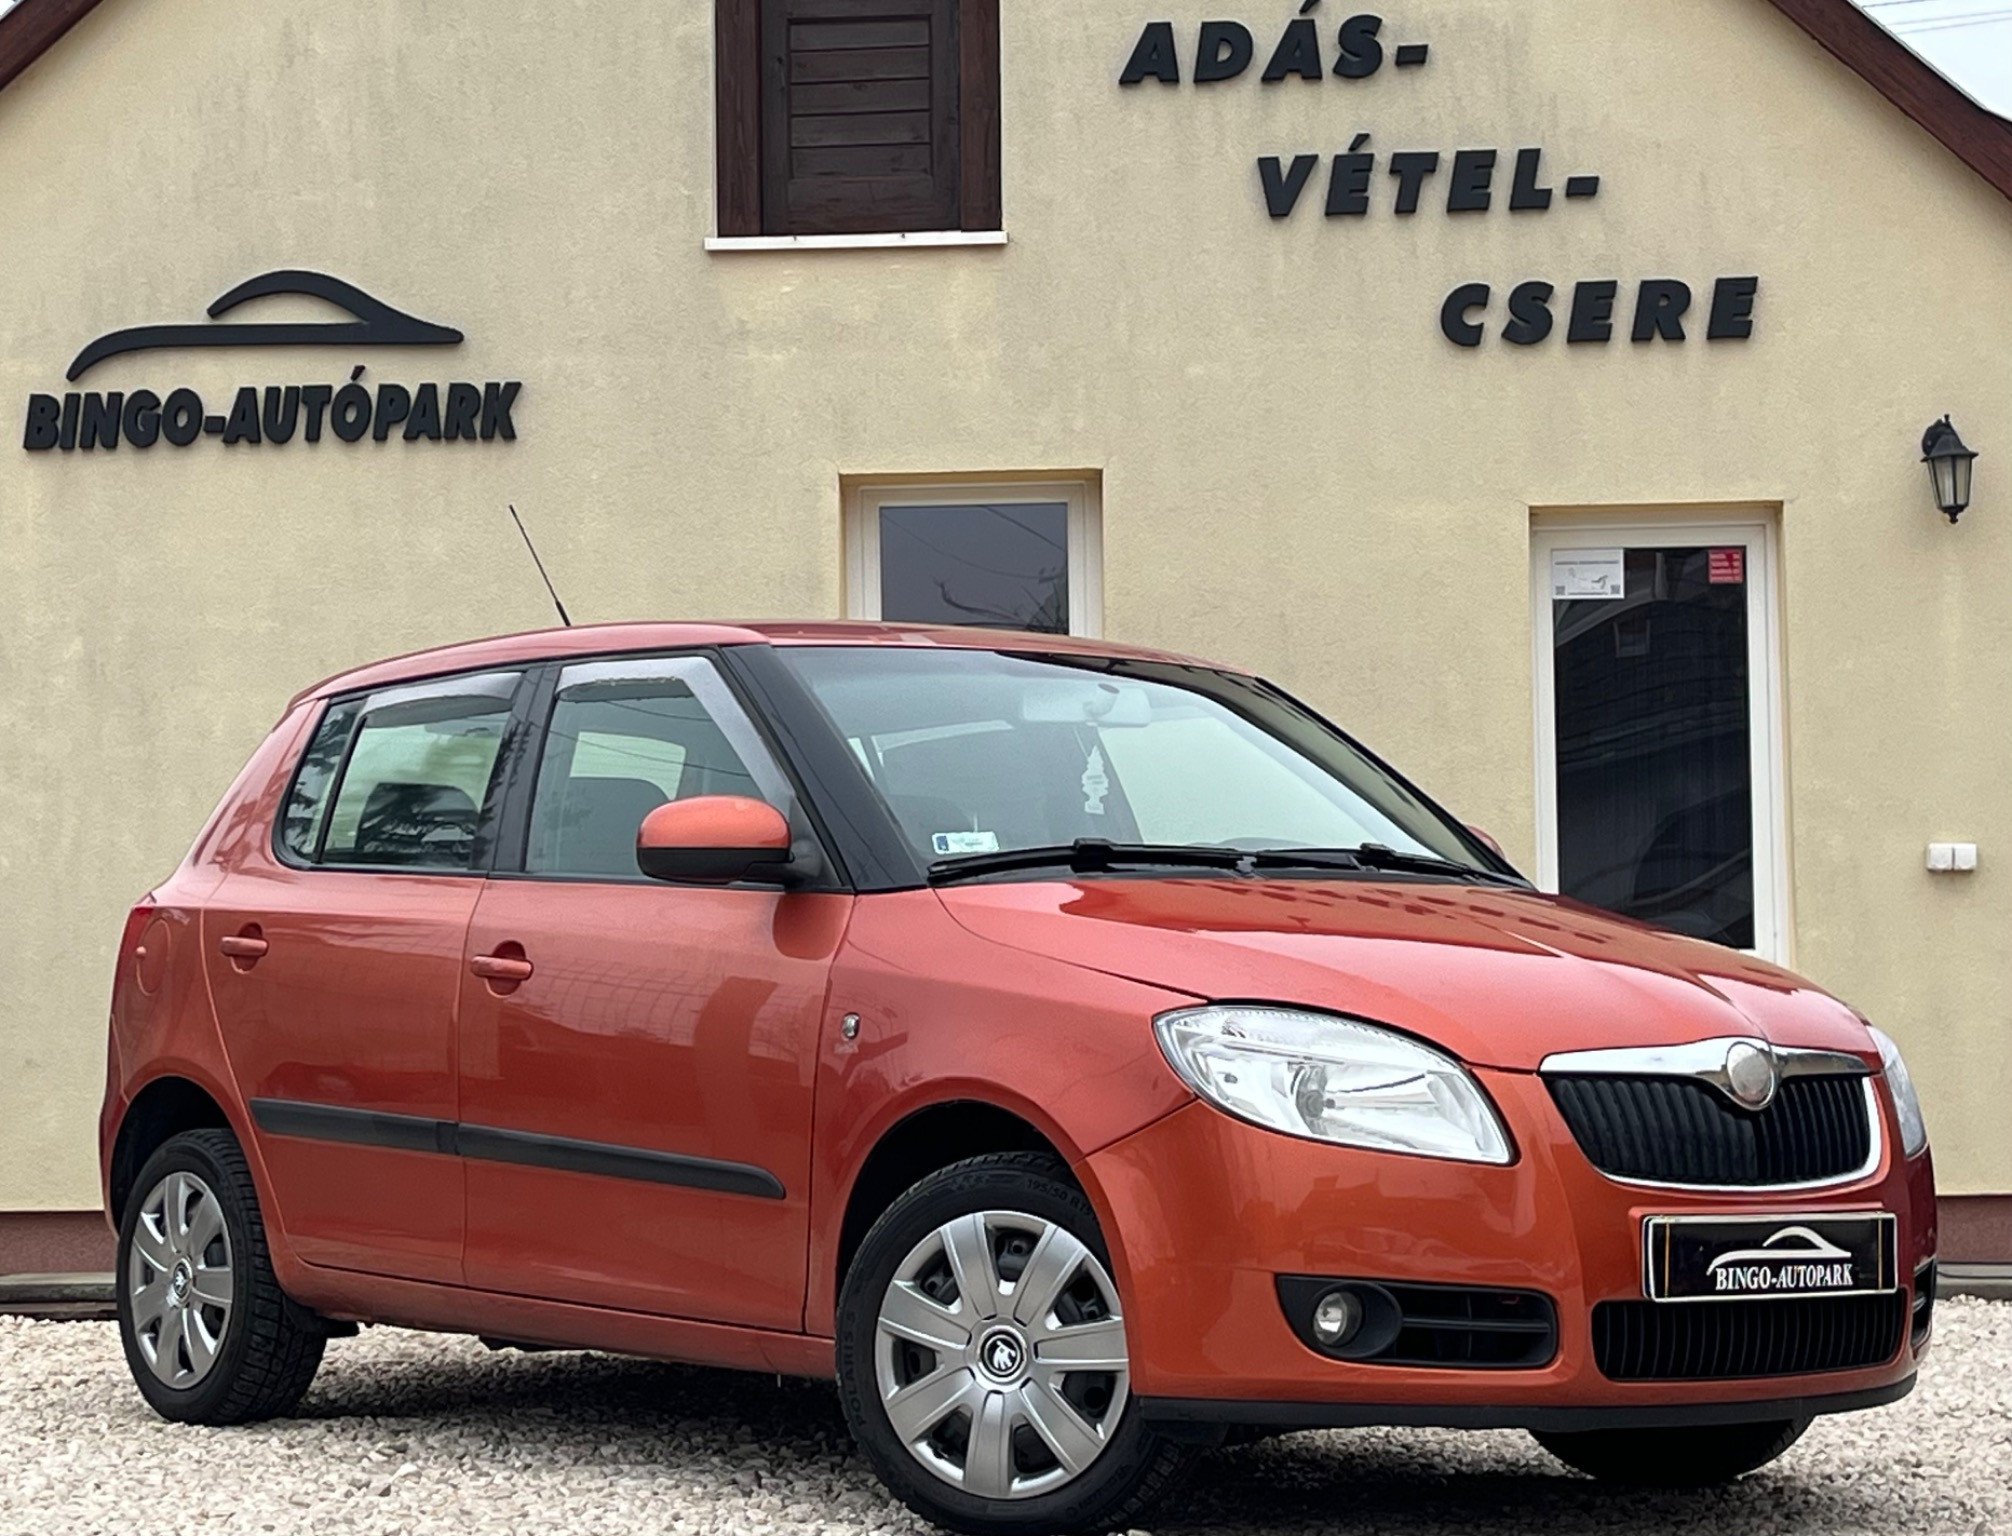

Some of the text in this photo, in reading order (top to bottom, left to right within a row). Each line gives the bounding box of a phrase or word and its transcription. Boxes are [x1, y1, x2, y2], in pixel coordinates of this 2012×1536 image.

[1119, 0, 1429, 85] ADÁS-
[1257, 132, 1600, 218] VÉTEL-
[1440, 275, 1758, 348] CSERE
[23, 364, 523, 452] BINGO-AUTÓPARK
[1715, 1263, 1853, 1290] BINGO-AUTOPARK
[843, 1331, 867, 1427] POLARIS
